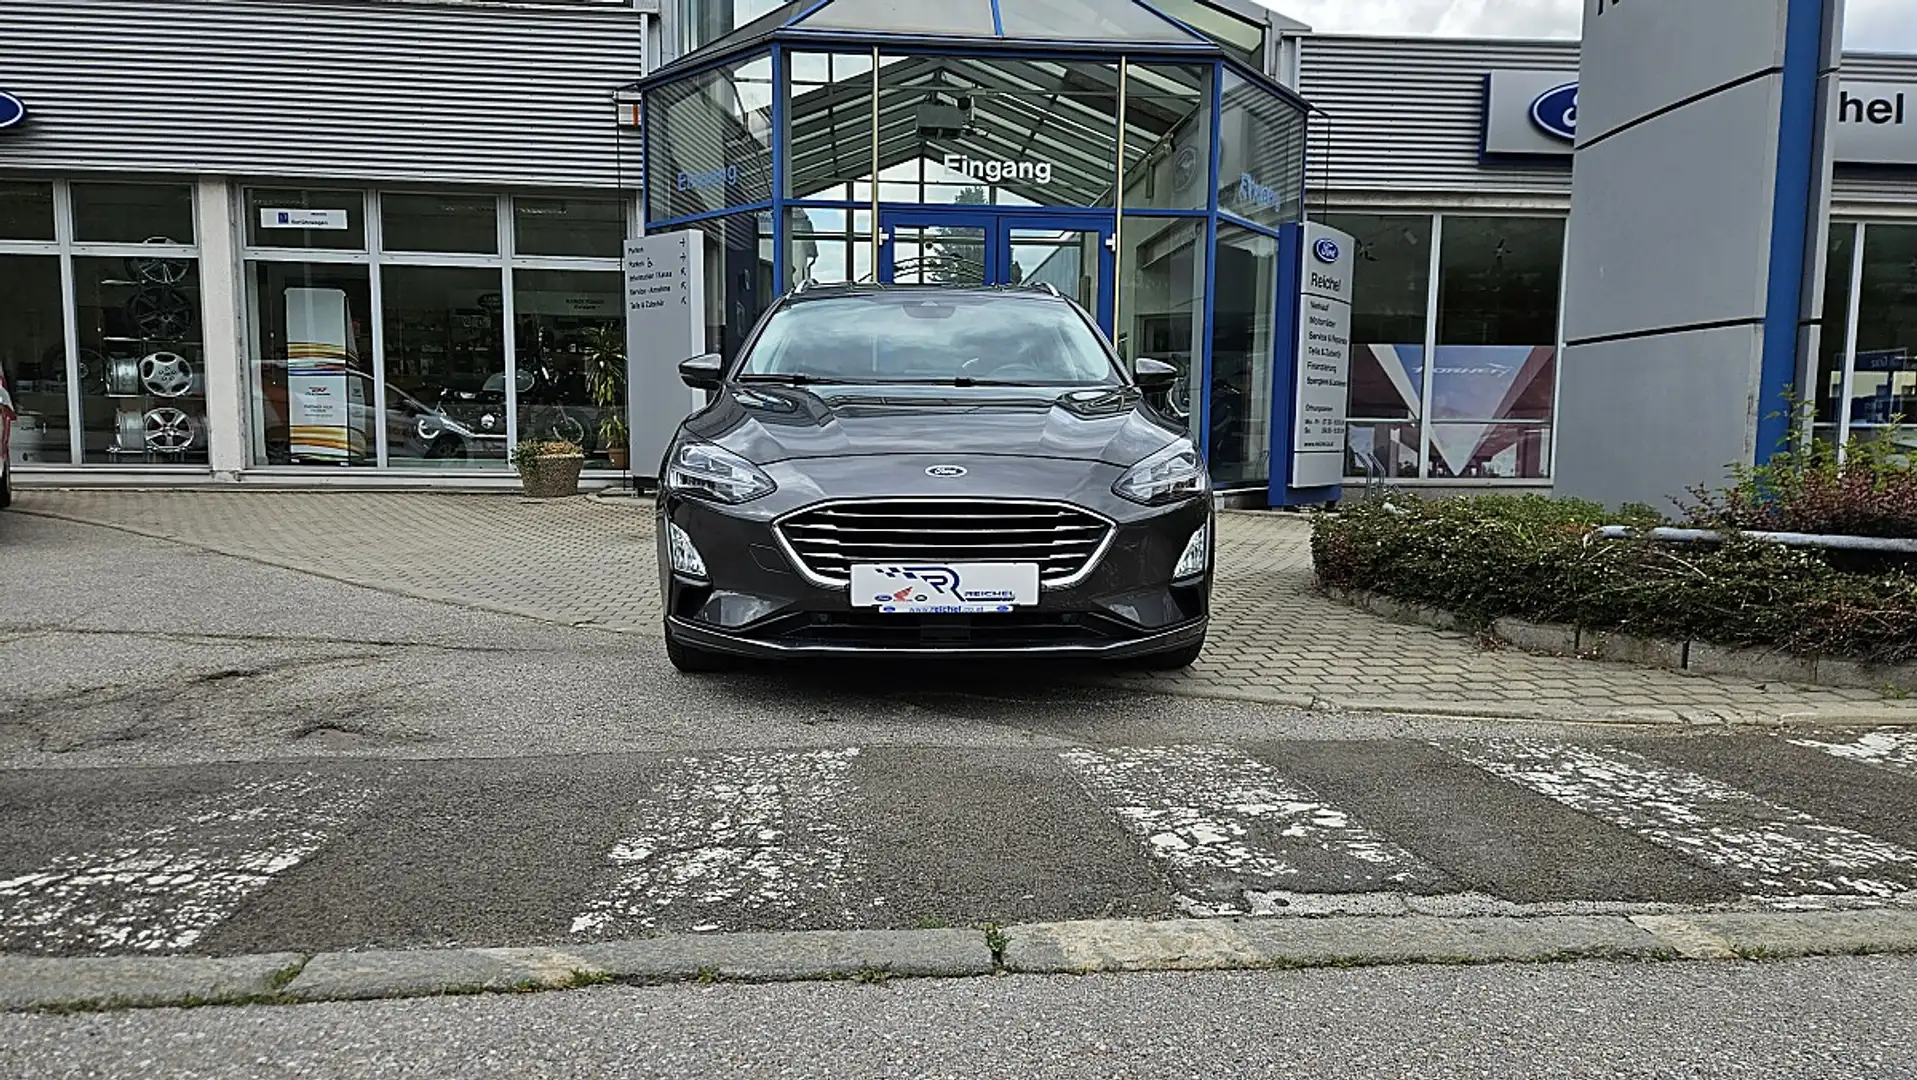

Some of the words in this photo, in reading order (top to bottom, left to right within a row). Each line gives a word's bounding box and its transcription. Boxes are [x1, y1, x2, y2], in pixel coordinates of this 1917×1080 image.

[1839, 91, 1904, 124] hel
[944, 154, 1051, 184] Eingang
[1311, 272, 1341, 292] Reichel
